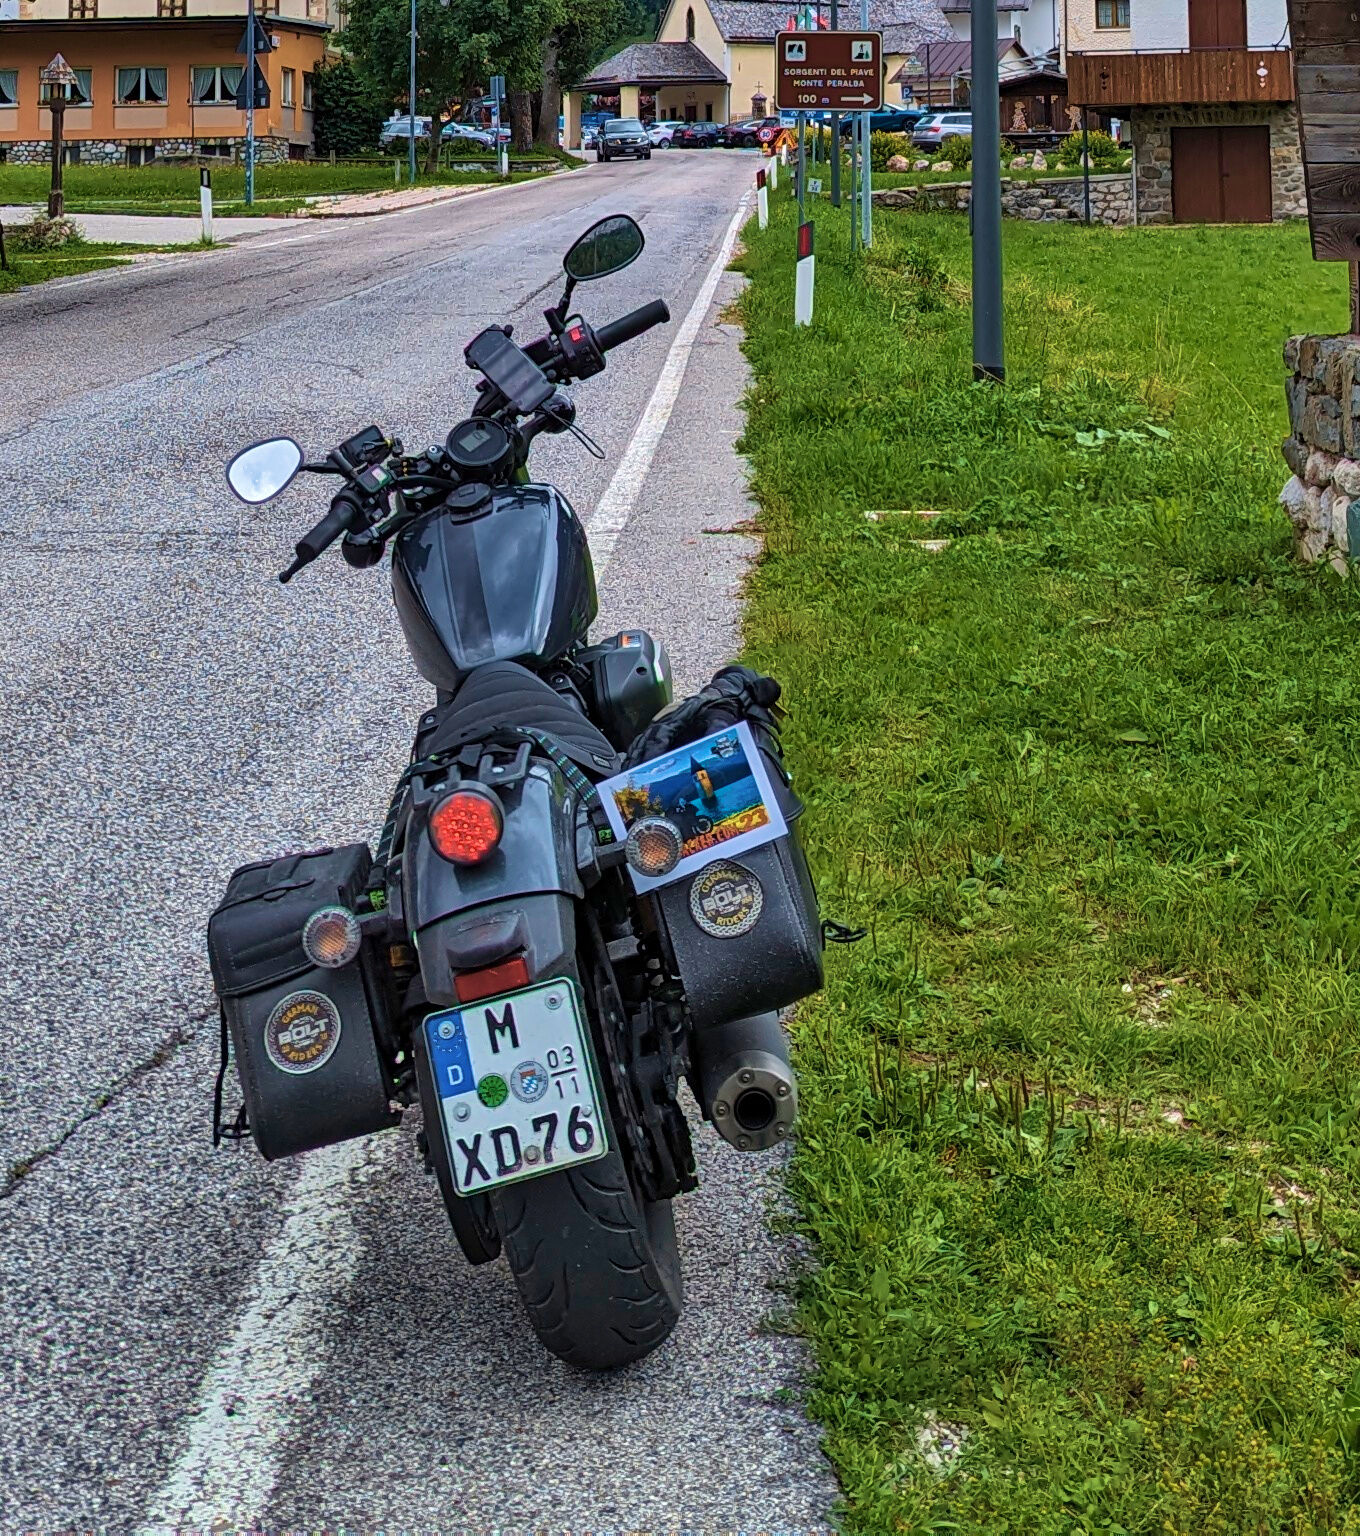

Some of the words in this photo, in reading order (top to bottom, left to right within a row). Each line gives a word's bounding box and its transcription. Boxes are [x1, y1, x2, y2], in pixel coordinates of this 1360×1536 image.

[784, 68, 827, 76] SORGENTI
[830, 68, 847, 76] DEL
[850, 68, 875, 76] PIAVE
[793, 79, 824, 87] MONTE
[826, 79, 865, 87] PERALBA
[798, 94, 818, 103] 100
[903, 87, 910, 98] P
[702, 884, 749, 911] BOLT
[715, 907, 749, 926] RIDERS
[278, 1018, 330, 1045] BOLT
[484, 1002, 520, 1054] M
[546, 1045, 575, 1069] 03
[446, 1064, 464, 1086] D
[554, 1076, 581, 1099] 11
